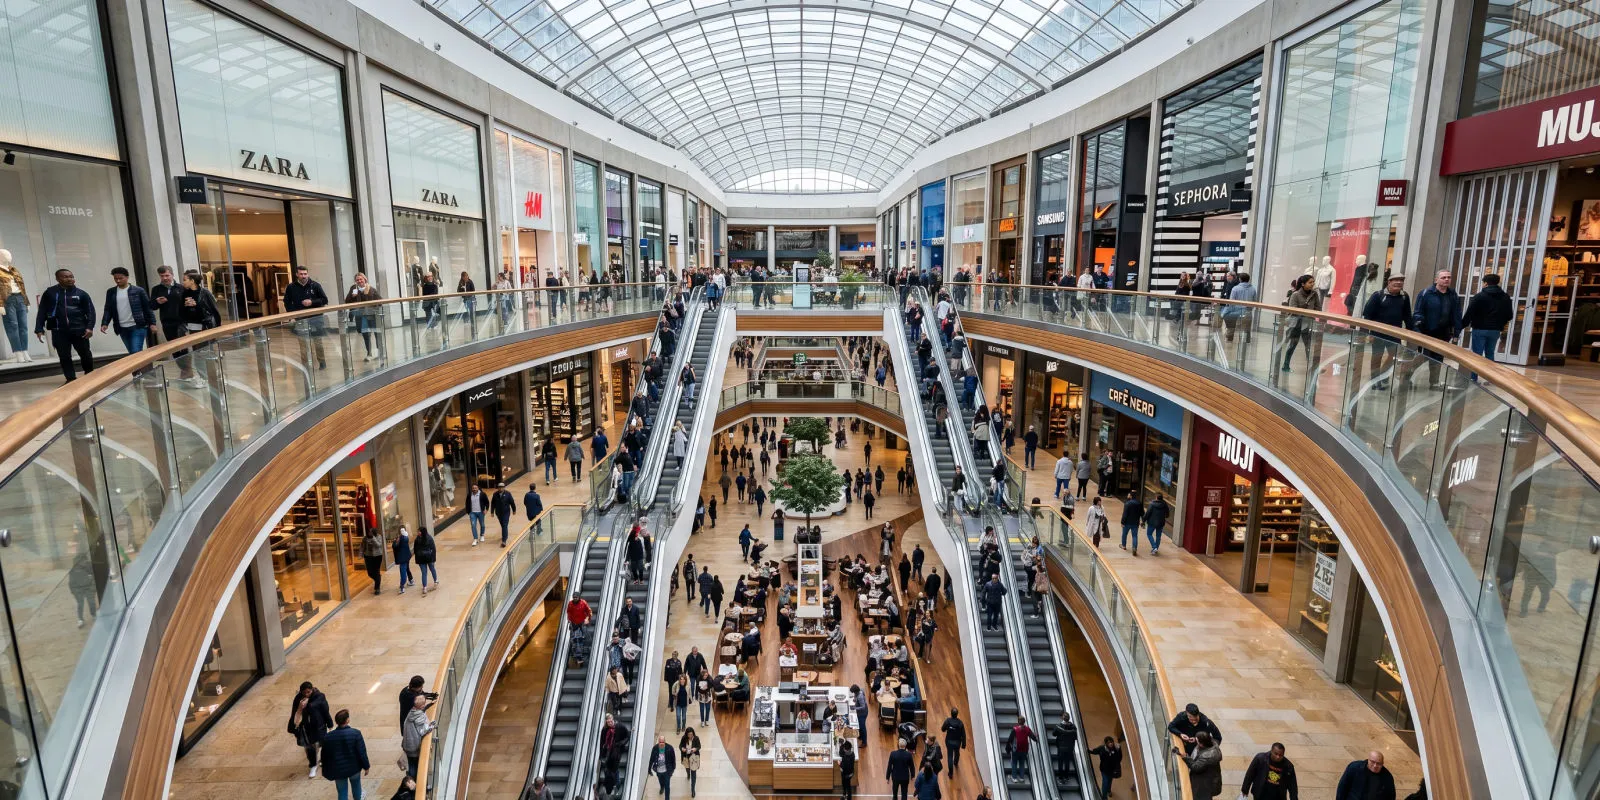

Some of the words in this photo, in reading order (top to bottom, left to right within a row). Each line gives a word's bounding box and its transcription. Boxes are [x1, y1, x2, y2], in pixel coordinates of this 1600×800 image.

[240, 149, 311, 181] ZARA
[421, 189, 459, 207] ZARA
[1174, 183, 1228, 206] SEPHORA
[1383, 187, 1403, 196] MUJI
[1037, 211, 1065, 226] SAMSUNG
[469, 387, 493, 404] MAC
[1130, 396, 1154, 418] NERO
[1218, 432, 1255, 473] MUJI
